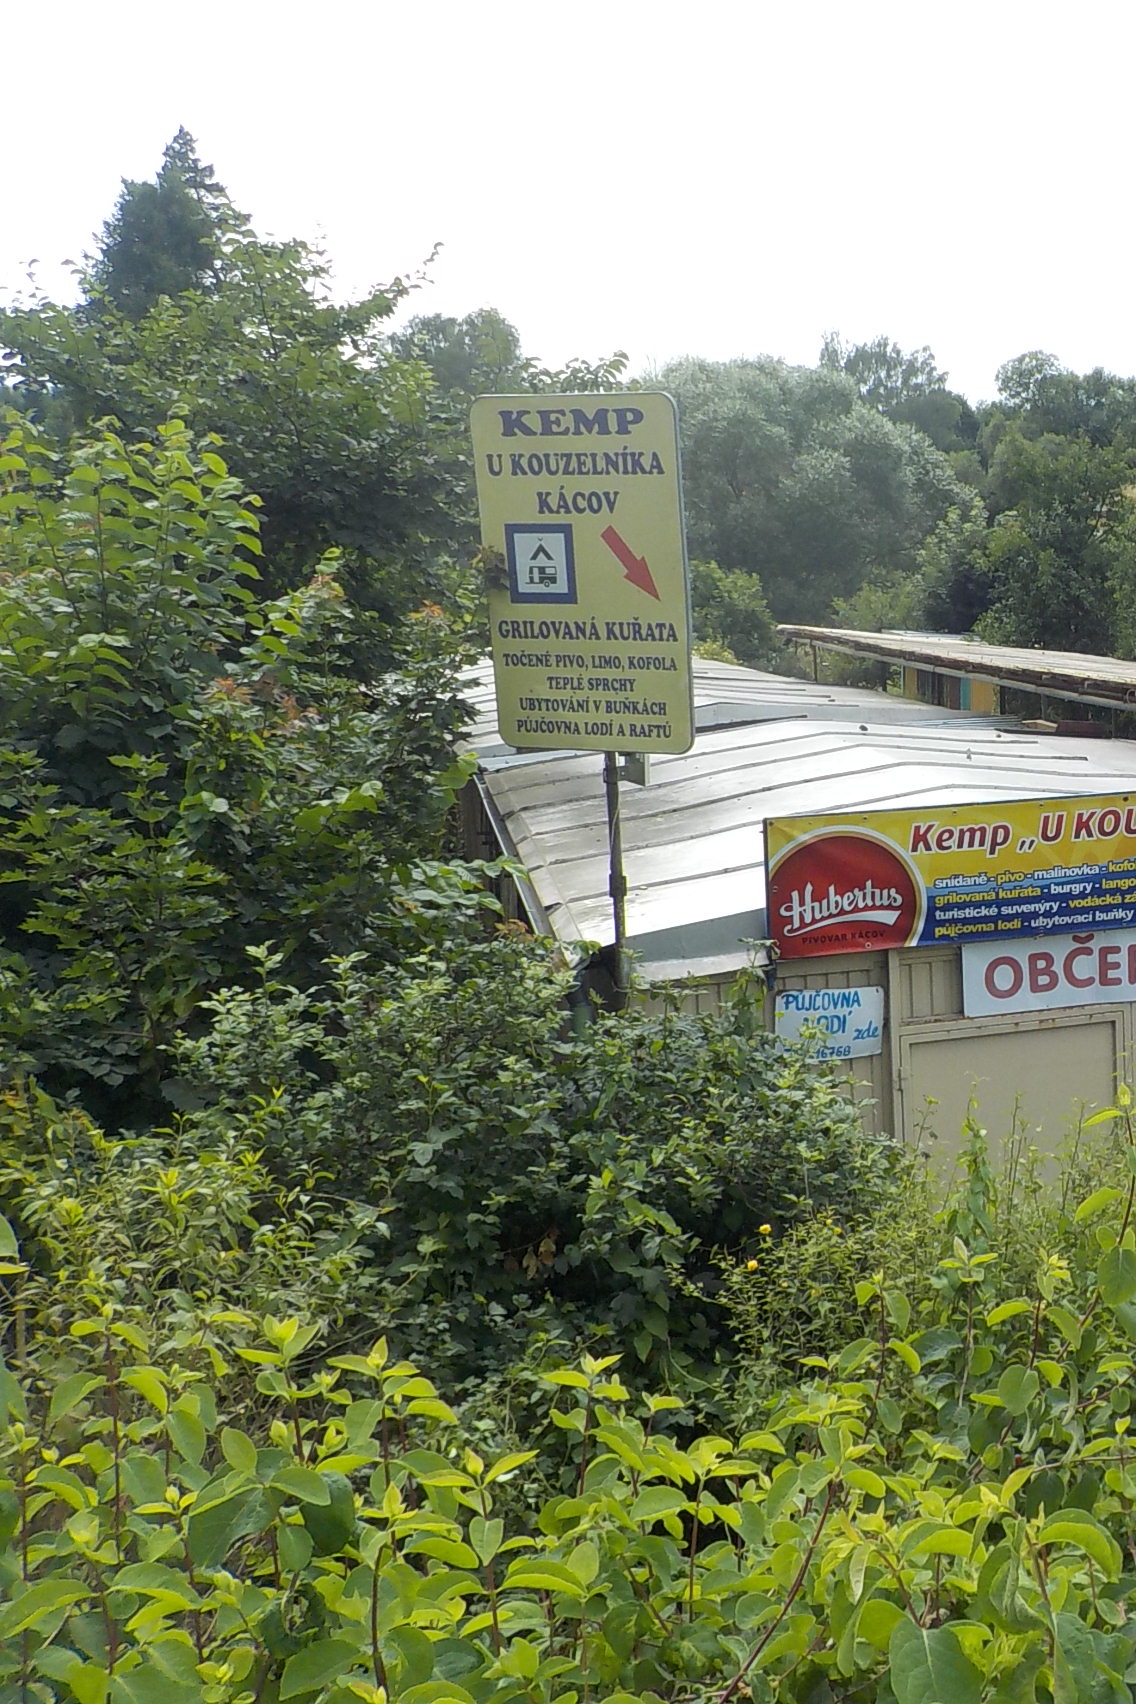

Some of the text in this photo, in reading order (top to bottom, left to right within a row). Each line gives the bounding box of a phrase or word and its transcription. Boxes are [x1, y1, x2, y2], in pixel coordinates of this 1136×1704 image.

[498, 407, 645, 437] KEMP
[486, 445, 666, 477] U KOUZELNÍKA
[536, 485, 620, 515] KÁCOV
[498, 616, 679, 642] GRILOVANÁ KUŘATA
[503, 650, 678, 672] TOČENÉ PIVO, LIMO, KOFOLA
[546, 674, 636, 692] TEPLÉ SPRCHY
[519, 696, 667, 716] UBYTOVÁNÍ V BUŇKÁCH
[584, 719, 613, 736] LODÍ
[616, 724, 626, 737] A
[910, 823, 1011, 857] Kemp
[935, 872, 987, 888] snídaně
[997, 871, 1025, 885] pivo
[1034, 864, 1100, 880] malinovka
[779, 879, 903, 932] Hubertus
[935, 889, 996, 907] grilovaná
[998, 886, 1041, 899] kuřata
[1050, 881, 1093, 896] burgry
[935, 905, 998, 920] turistické
[1001, 900, 1060, 914] suvenýry
[1069, 893, 1122, 909] vodácká
[998, 918, 1021, 931] lodí
[1031, 911, 1092, 929] ubytovací
[1095, 908, 1134, 921] buňky
[802, 934, 848, 945] PIVOVAR
[853, 1020, 880, 1040] zde
